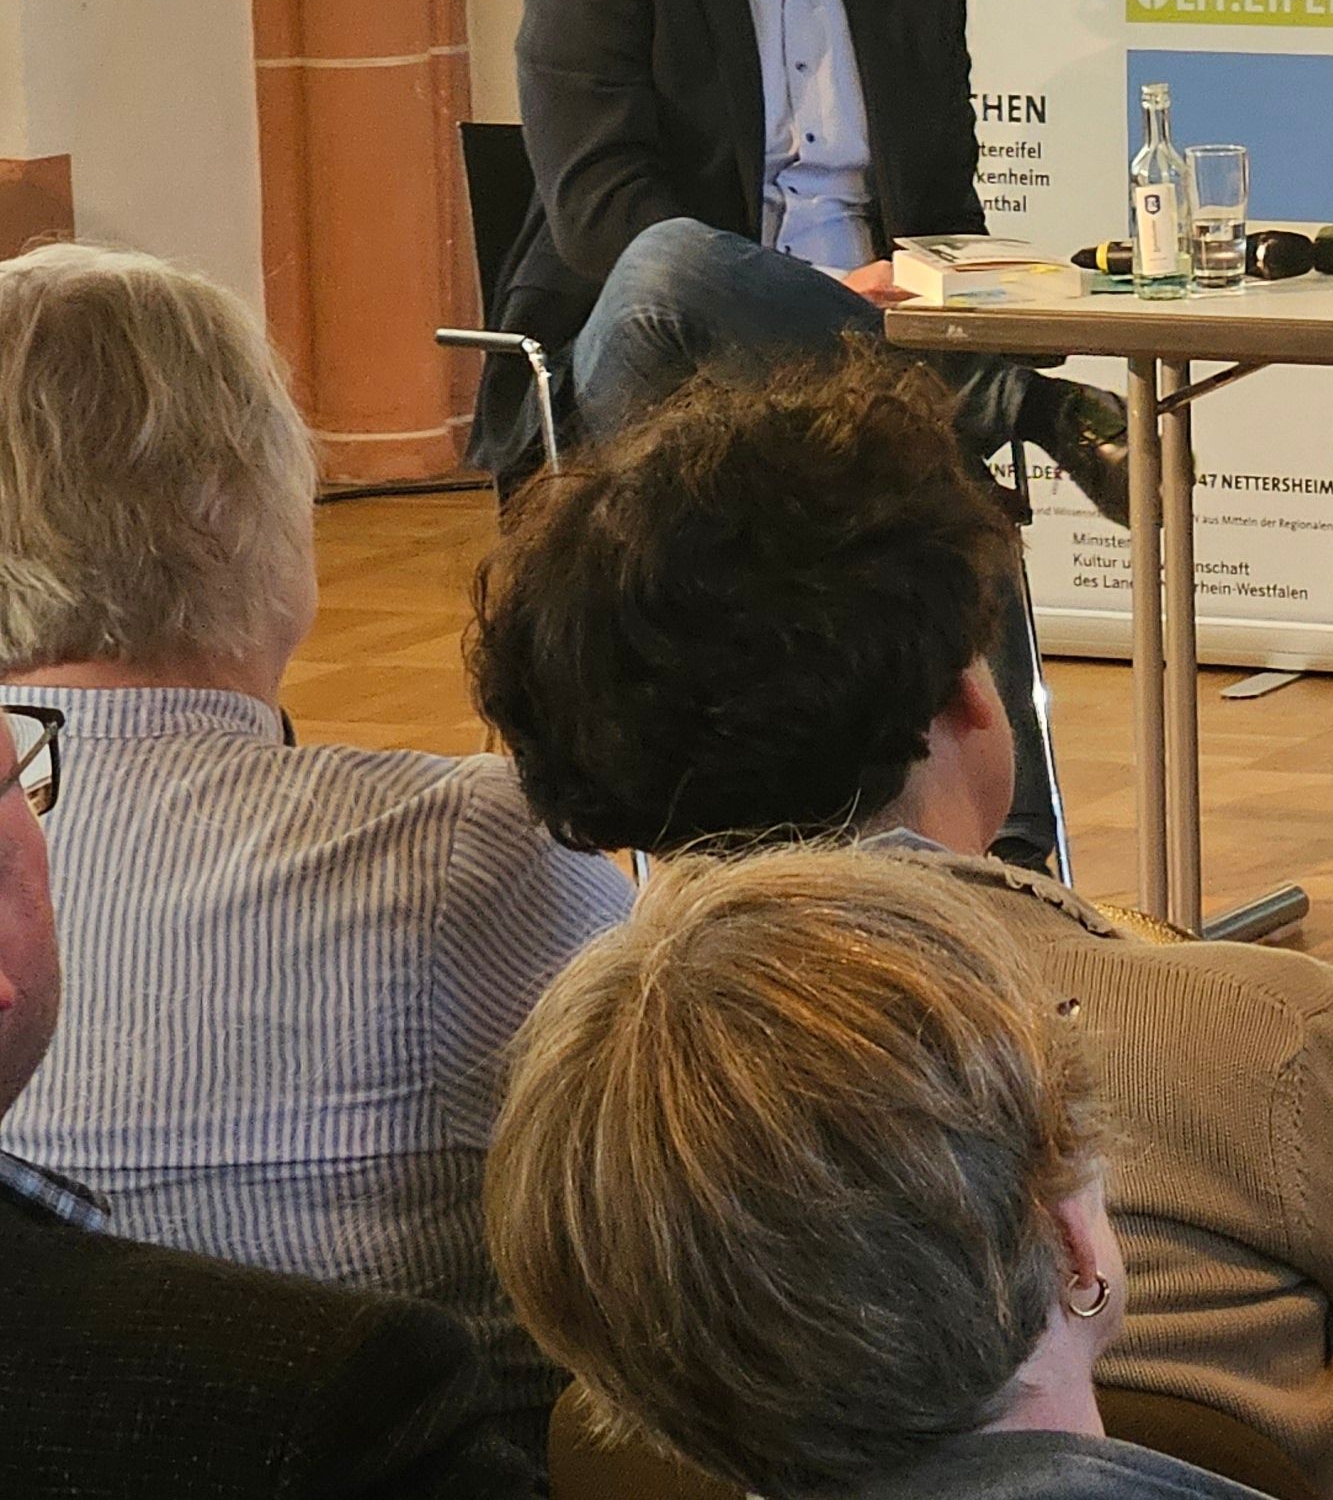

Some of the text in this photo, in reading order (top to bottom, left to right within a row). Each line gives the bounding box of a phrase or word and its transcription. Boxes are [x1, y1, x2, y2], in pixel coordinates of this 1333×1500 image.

[977, 168, 1050, 186] kenheim
[1073, 554, 1117, 568] Kultur
[1074, 574, 1098, 587] des
